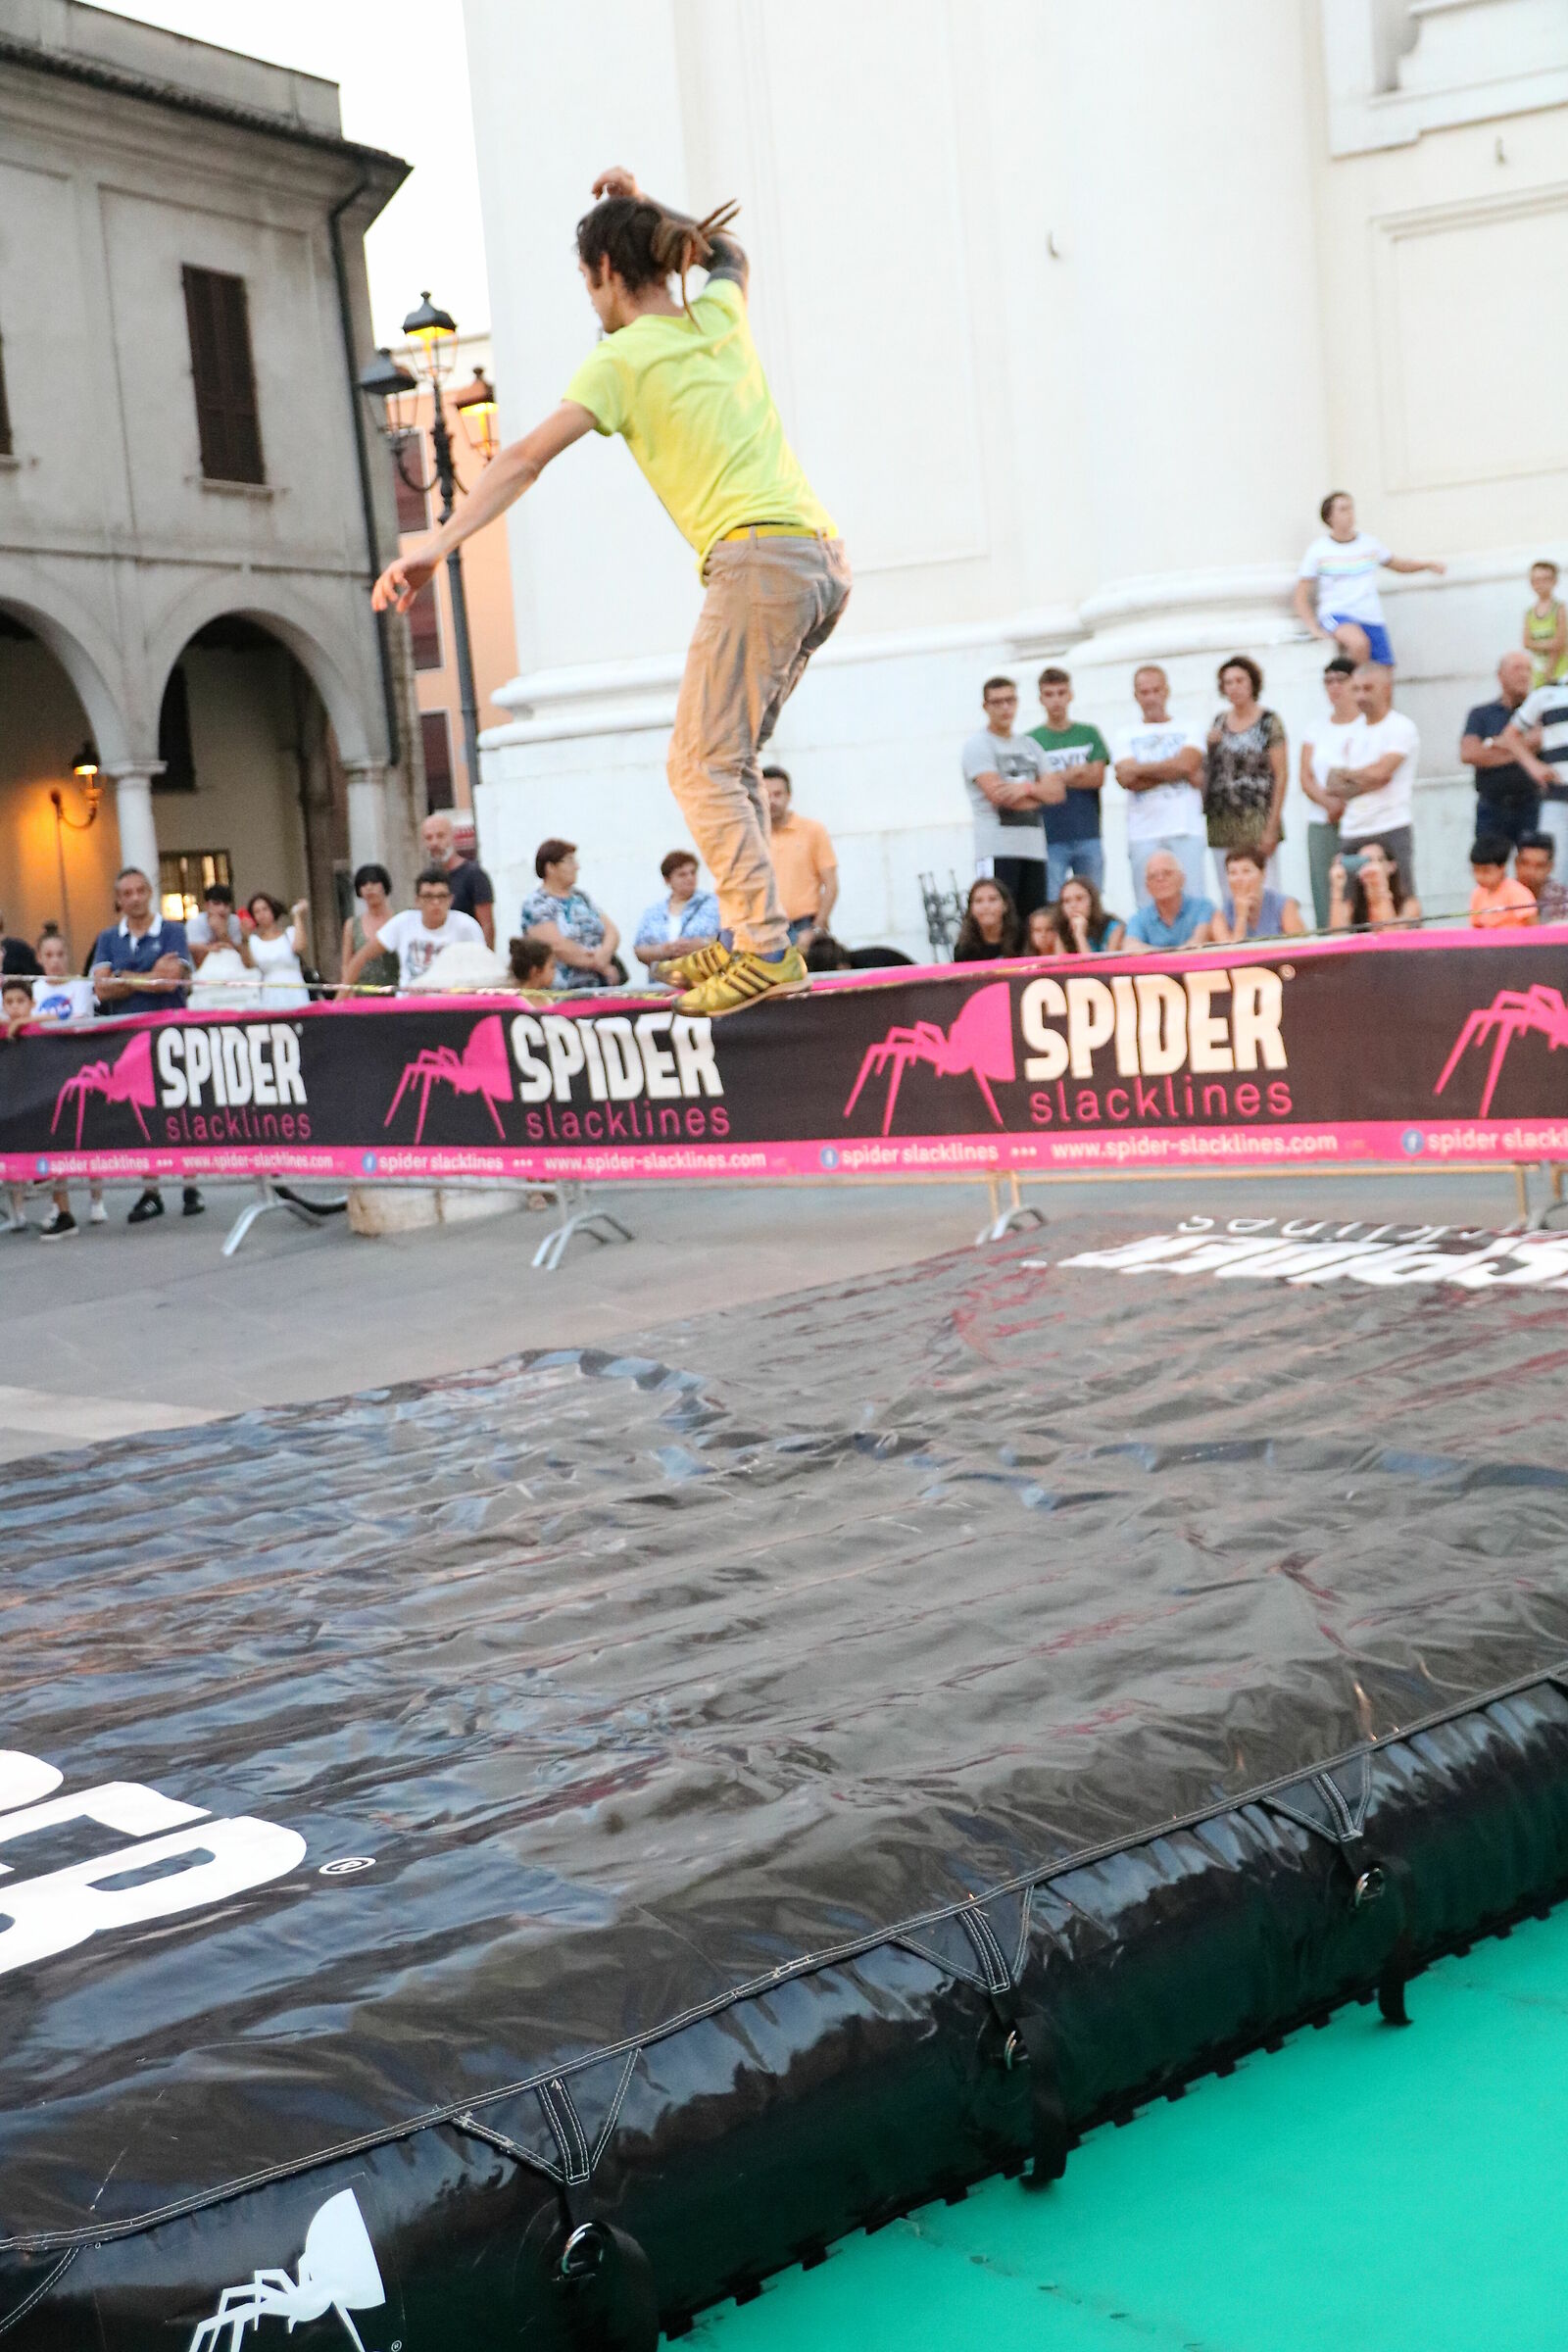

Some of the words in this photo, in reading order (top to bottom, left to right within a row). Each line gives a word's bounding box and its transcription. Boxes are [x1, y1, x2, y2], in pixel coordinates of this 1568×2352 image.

[1020, 966, 1289, 1082] SPIDER
[158, 1023, 308, 1108] SPIDER
[511, 1013, 724, 1102] SPIDER
[525, 1099, 730, 1141] slacklines
[1029, 1075, 1294, 1125] slacklines
[166, 1104, 313, 1142] slacklines
[1428, 1129, 1499, 1156] spider
[51, 1158, 88, 1175] spider
[90, 1156, 150, 1171] slacklines
[379, 1152, 427, 1174] spider
[429, 1151, 504, 1170] slacklines
[544, 1150, 766, 1173] www.spider-slacklines.com
[842, 1146, 899, 1169] spider
[903, 1142, 999, 1163] slacklines
[1051, 1130, 1339, 1161] www.spider-slacklines.com
